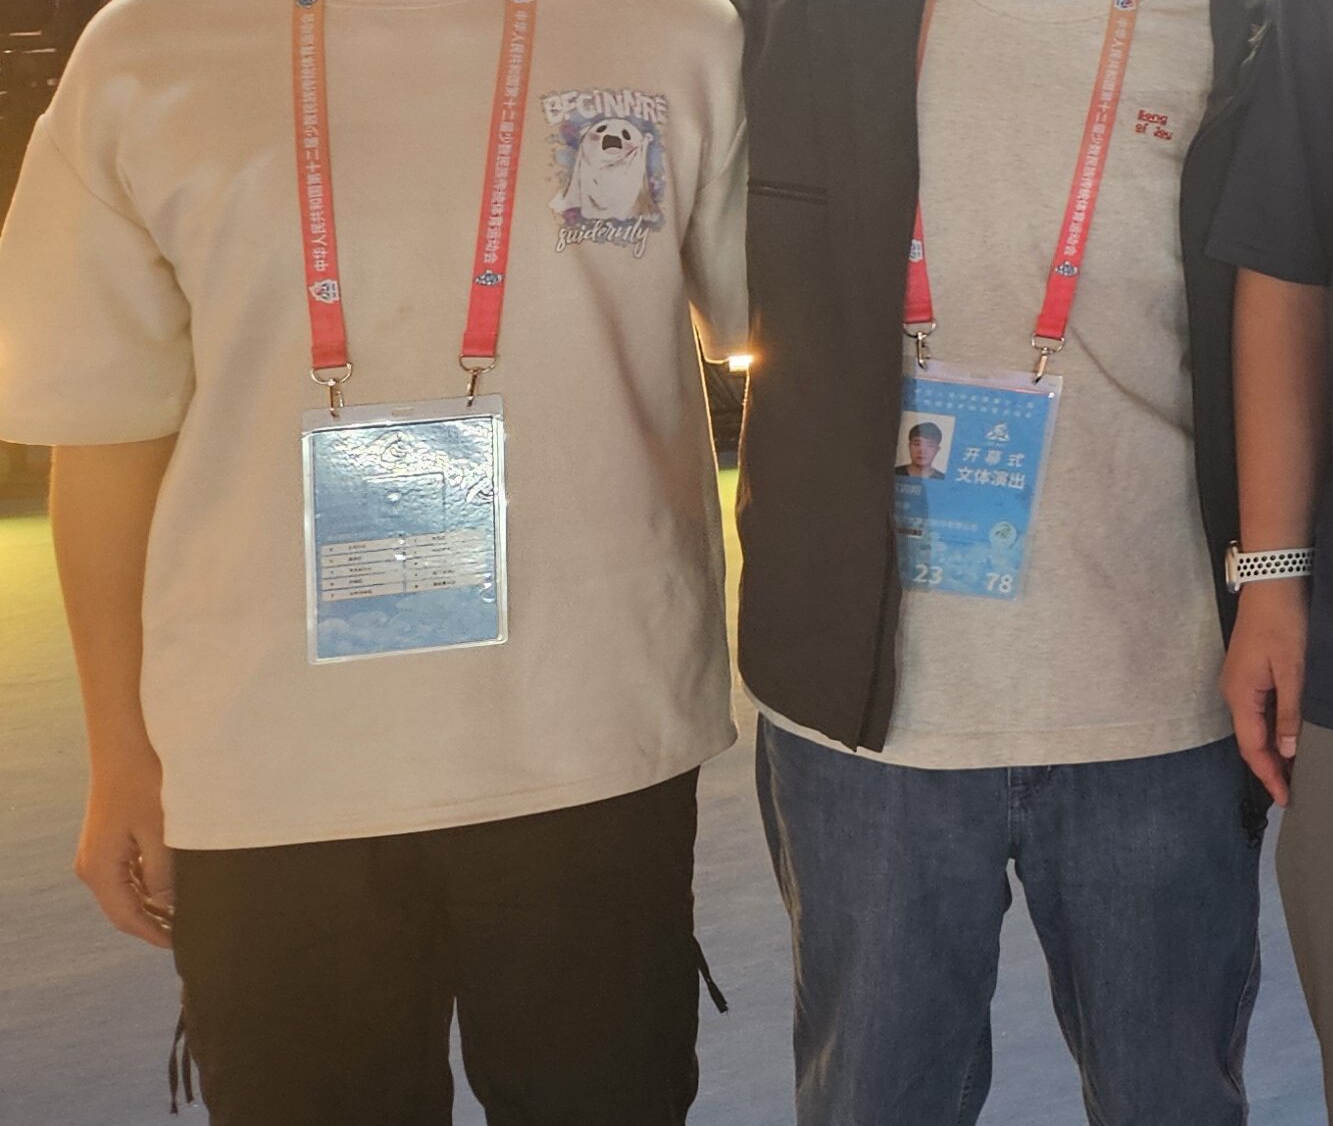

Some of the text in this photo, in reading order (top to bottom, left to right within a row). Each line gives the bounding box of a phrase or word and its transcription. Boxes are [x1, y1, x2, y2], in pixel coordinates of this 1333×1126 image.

[484, 10, 529, 264] 中华人民共和国第十二届少数民族传统体育运动会
[962, 447, 1026, 468] 开幕式
[955, 467, 1027, 490] 文体演出
[912, 564, 1014, 594] 23 78
